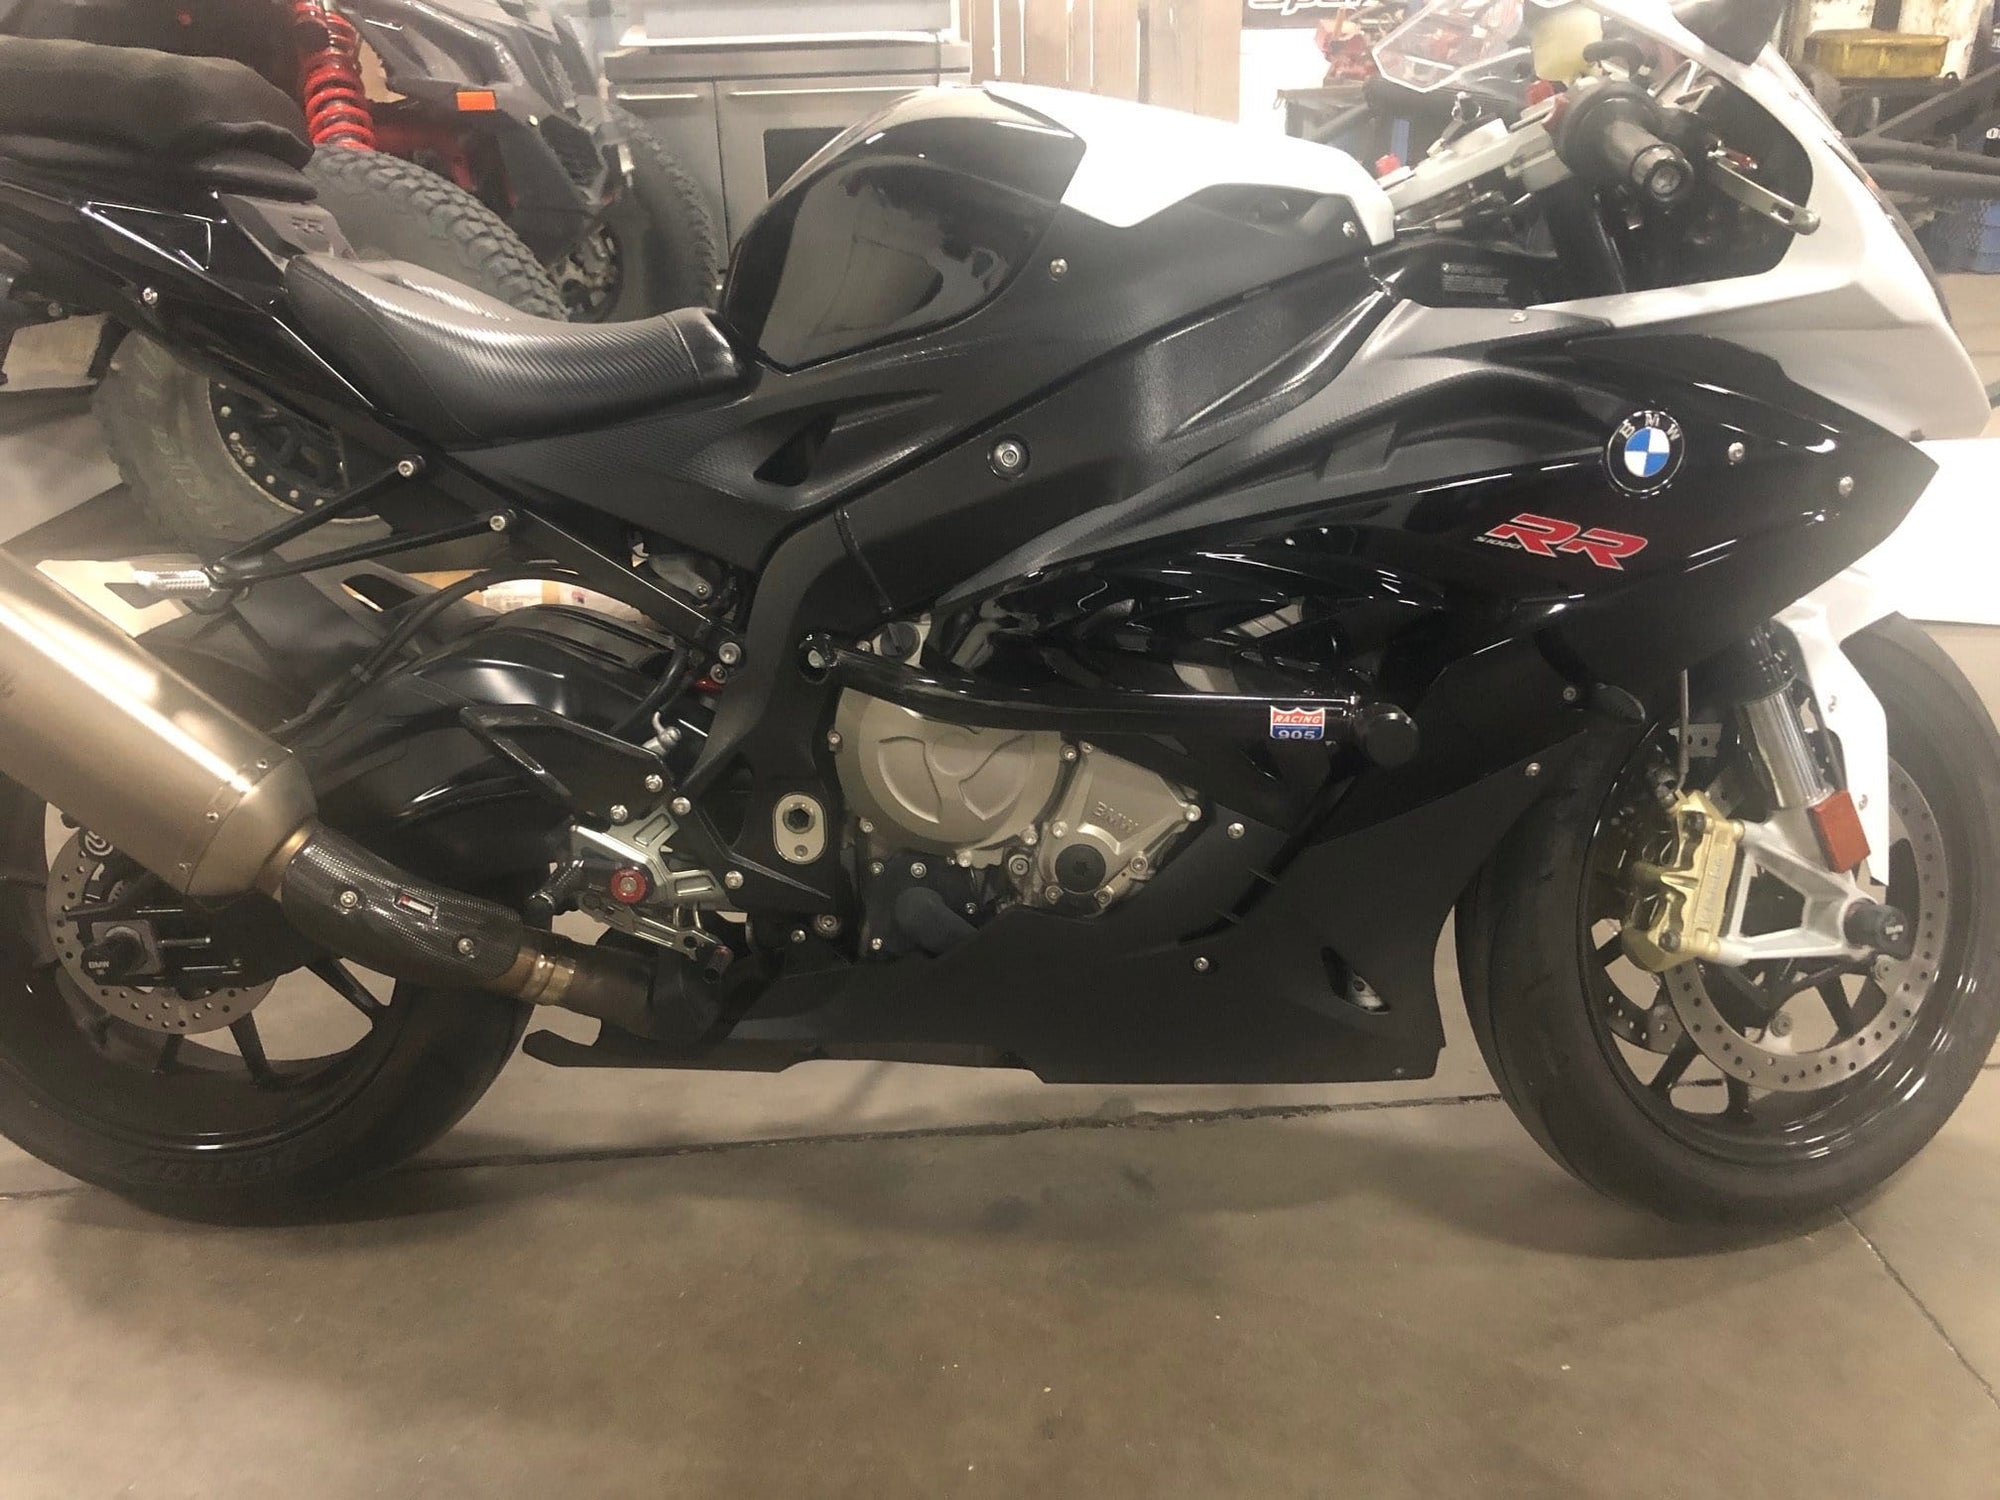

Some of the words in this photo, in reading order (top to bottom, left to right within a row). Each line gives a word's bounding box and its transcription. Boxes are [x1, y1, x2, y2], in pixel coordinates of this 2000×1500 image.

[1619, 413, 1680, 441] BMW
[1473, 535, 1522, 550] S1000
[1484, 512, 1648, 571] RR
[1274, 714, 1321, 724] RACING
[1278, 729, 1316, 740] 905
